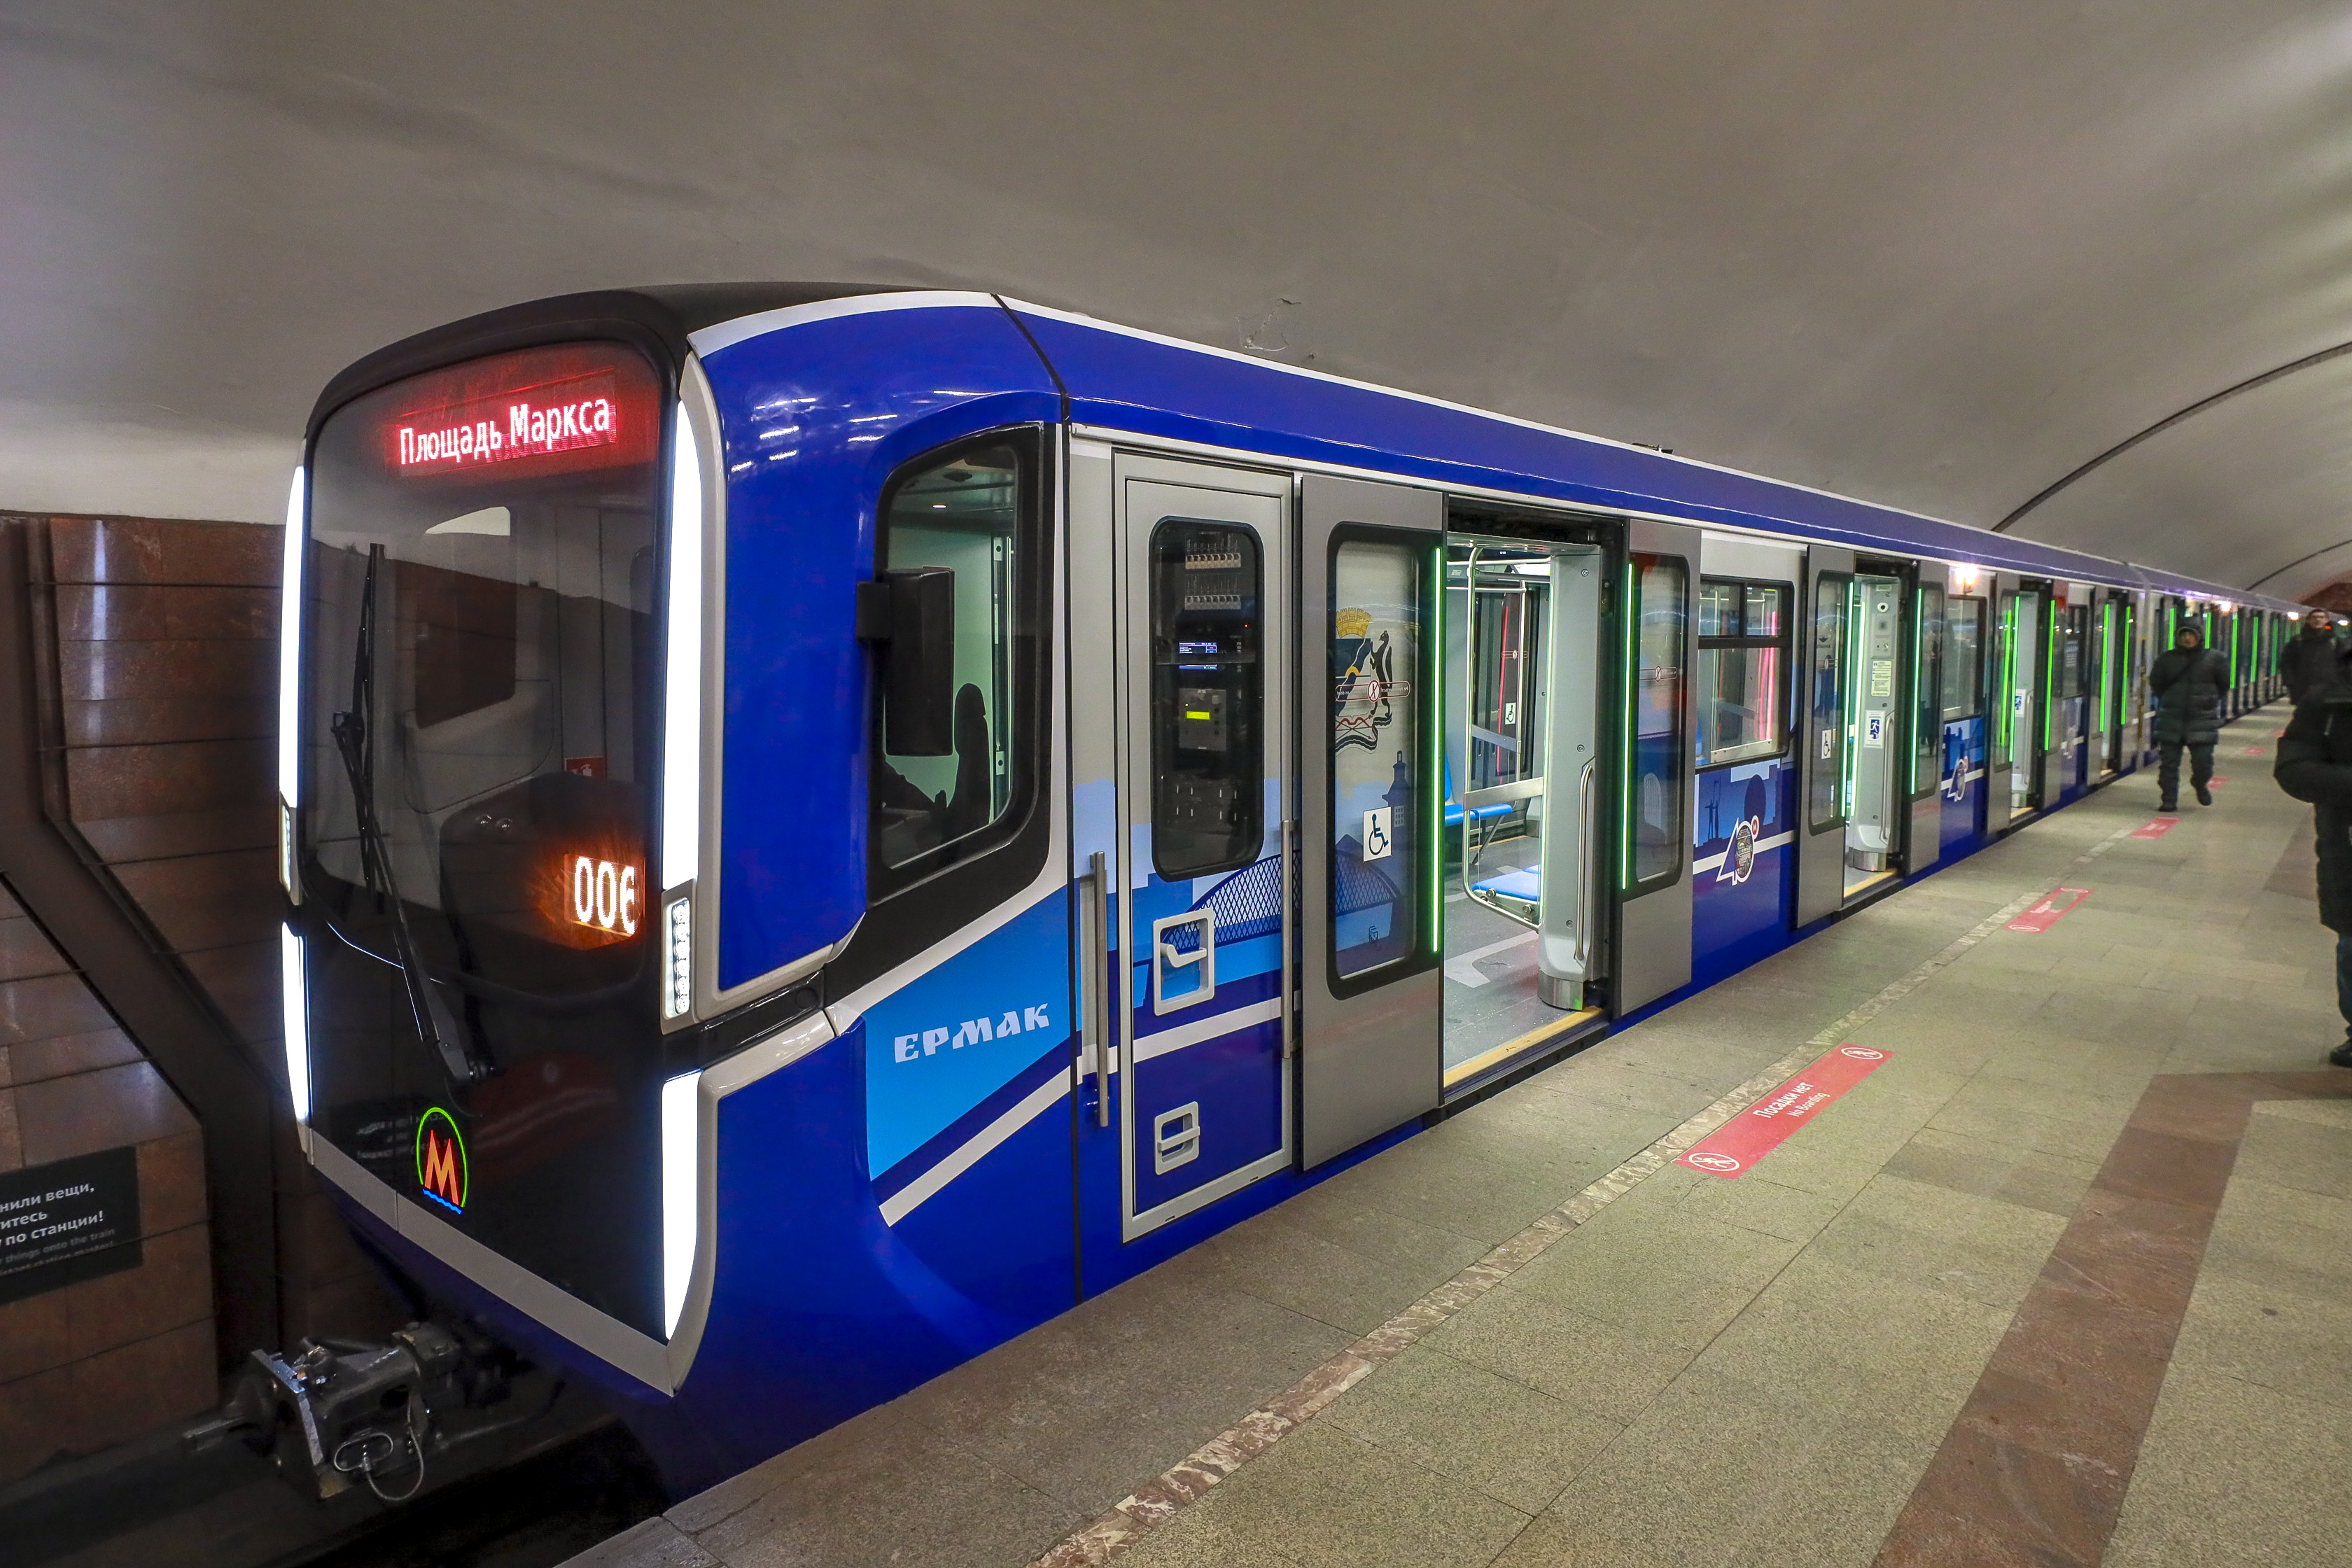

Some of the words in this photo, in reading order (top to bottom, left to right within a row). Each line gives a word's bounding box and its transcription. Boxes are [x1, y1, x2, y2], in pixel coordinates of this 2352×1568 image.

[400, 420, 502, 465] Площадь
[510, 398, 610, 450] Маркса
[894, 1002, 1050, 1063] ЕРМАК
[1752, 1092, 1801, 1119] Посадки
[1791, 1082, 1814, 1094] нет
[1786, 1109, 1805, 1117] No
[1794, 1092, 1831, 1111] Boarding
[45, 1182, 95, 1203] вещи,
[5, 1233, 27, 1246] по
[30, 1210, 104, 1240] станции!
[90, 1228, 116, 1241] train
